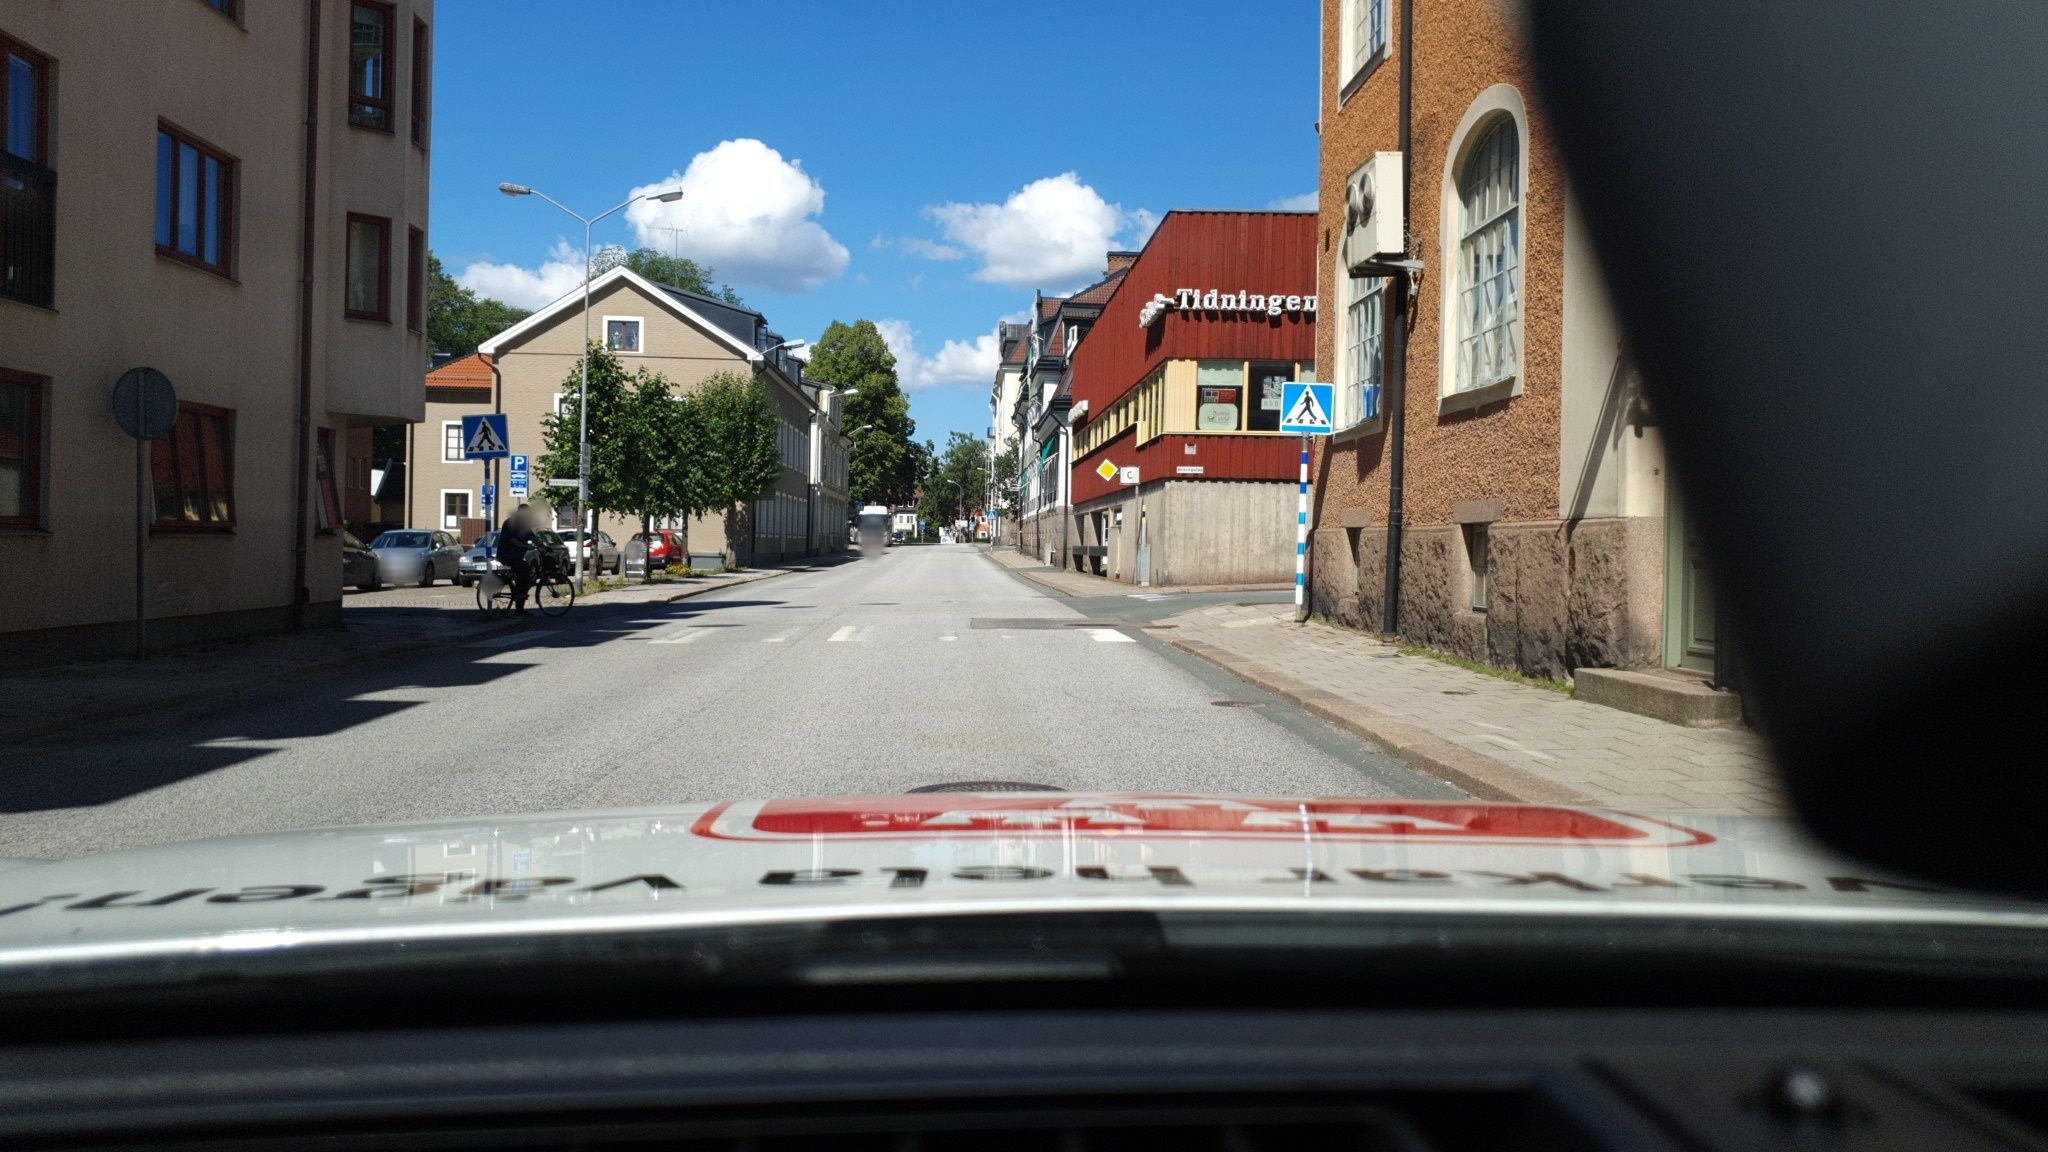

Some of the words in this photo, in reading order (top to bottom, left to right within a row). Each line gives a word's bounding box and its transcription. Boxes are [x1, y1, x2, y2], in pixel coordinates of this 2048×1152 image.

[1177, 288, 1317, 315] Tidningen
[514, 456, 525, 470] P
[1126, 471, 1134, 480] C
